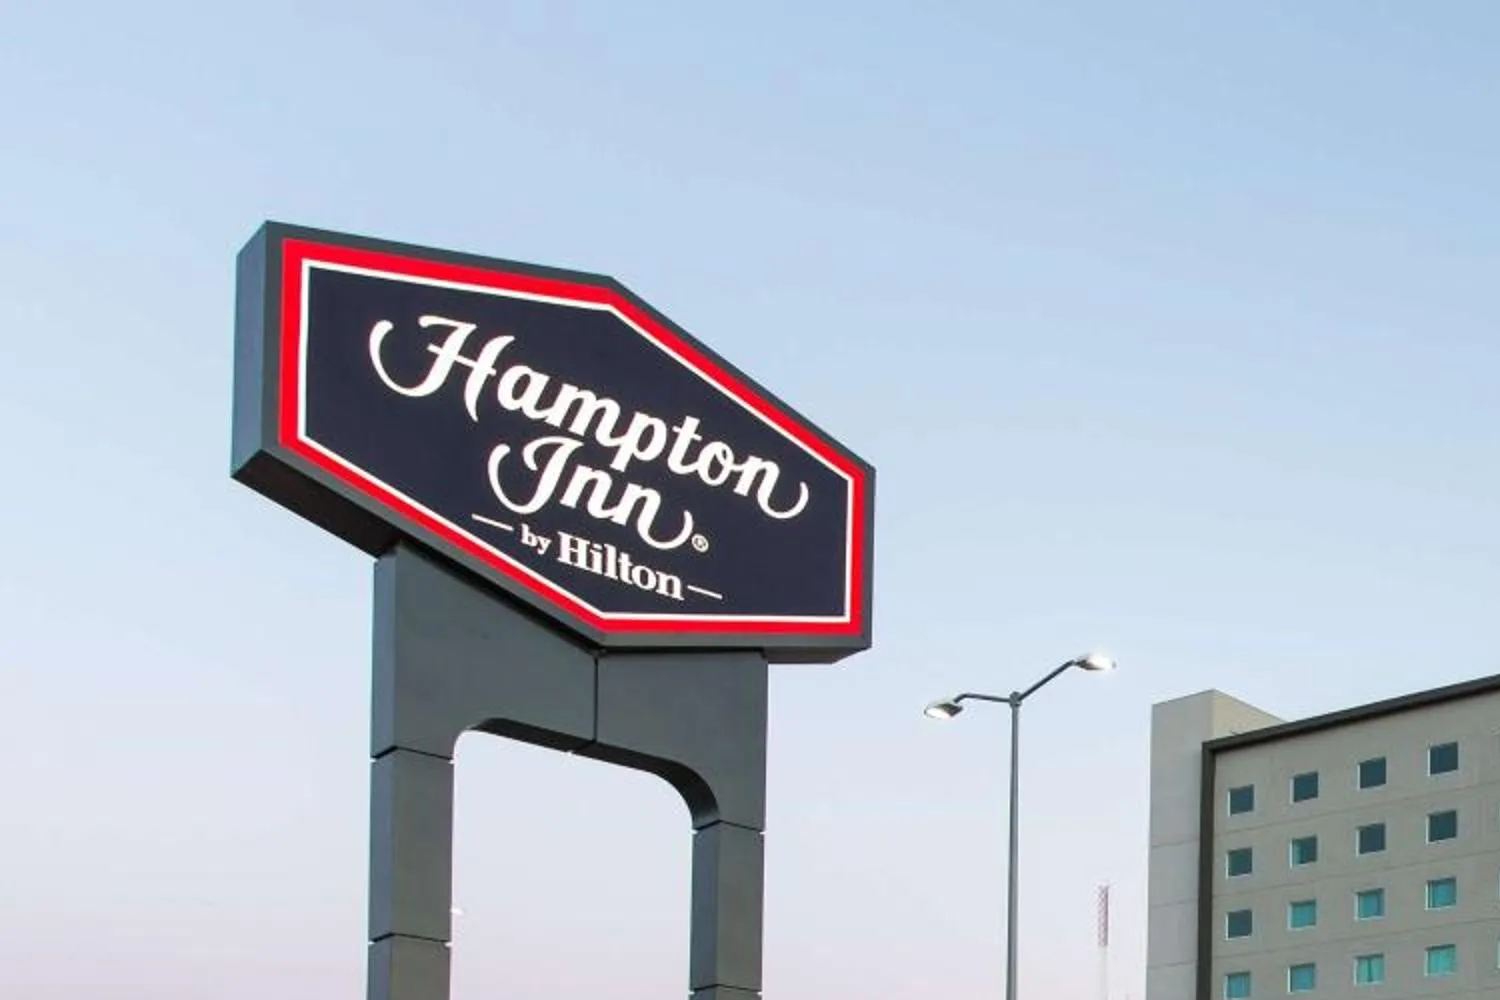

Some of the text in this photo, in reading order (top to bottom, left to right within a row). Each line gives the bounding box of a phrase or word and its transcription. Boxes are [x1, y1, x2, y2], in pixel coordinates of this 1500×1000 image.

[369, 315, 809, 519] Hampton
[520, 524, 685, 600] by Hilton
